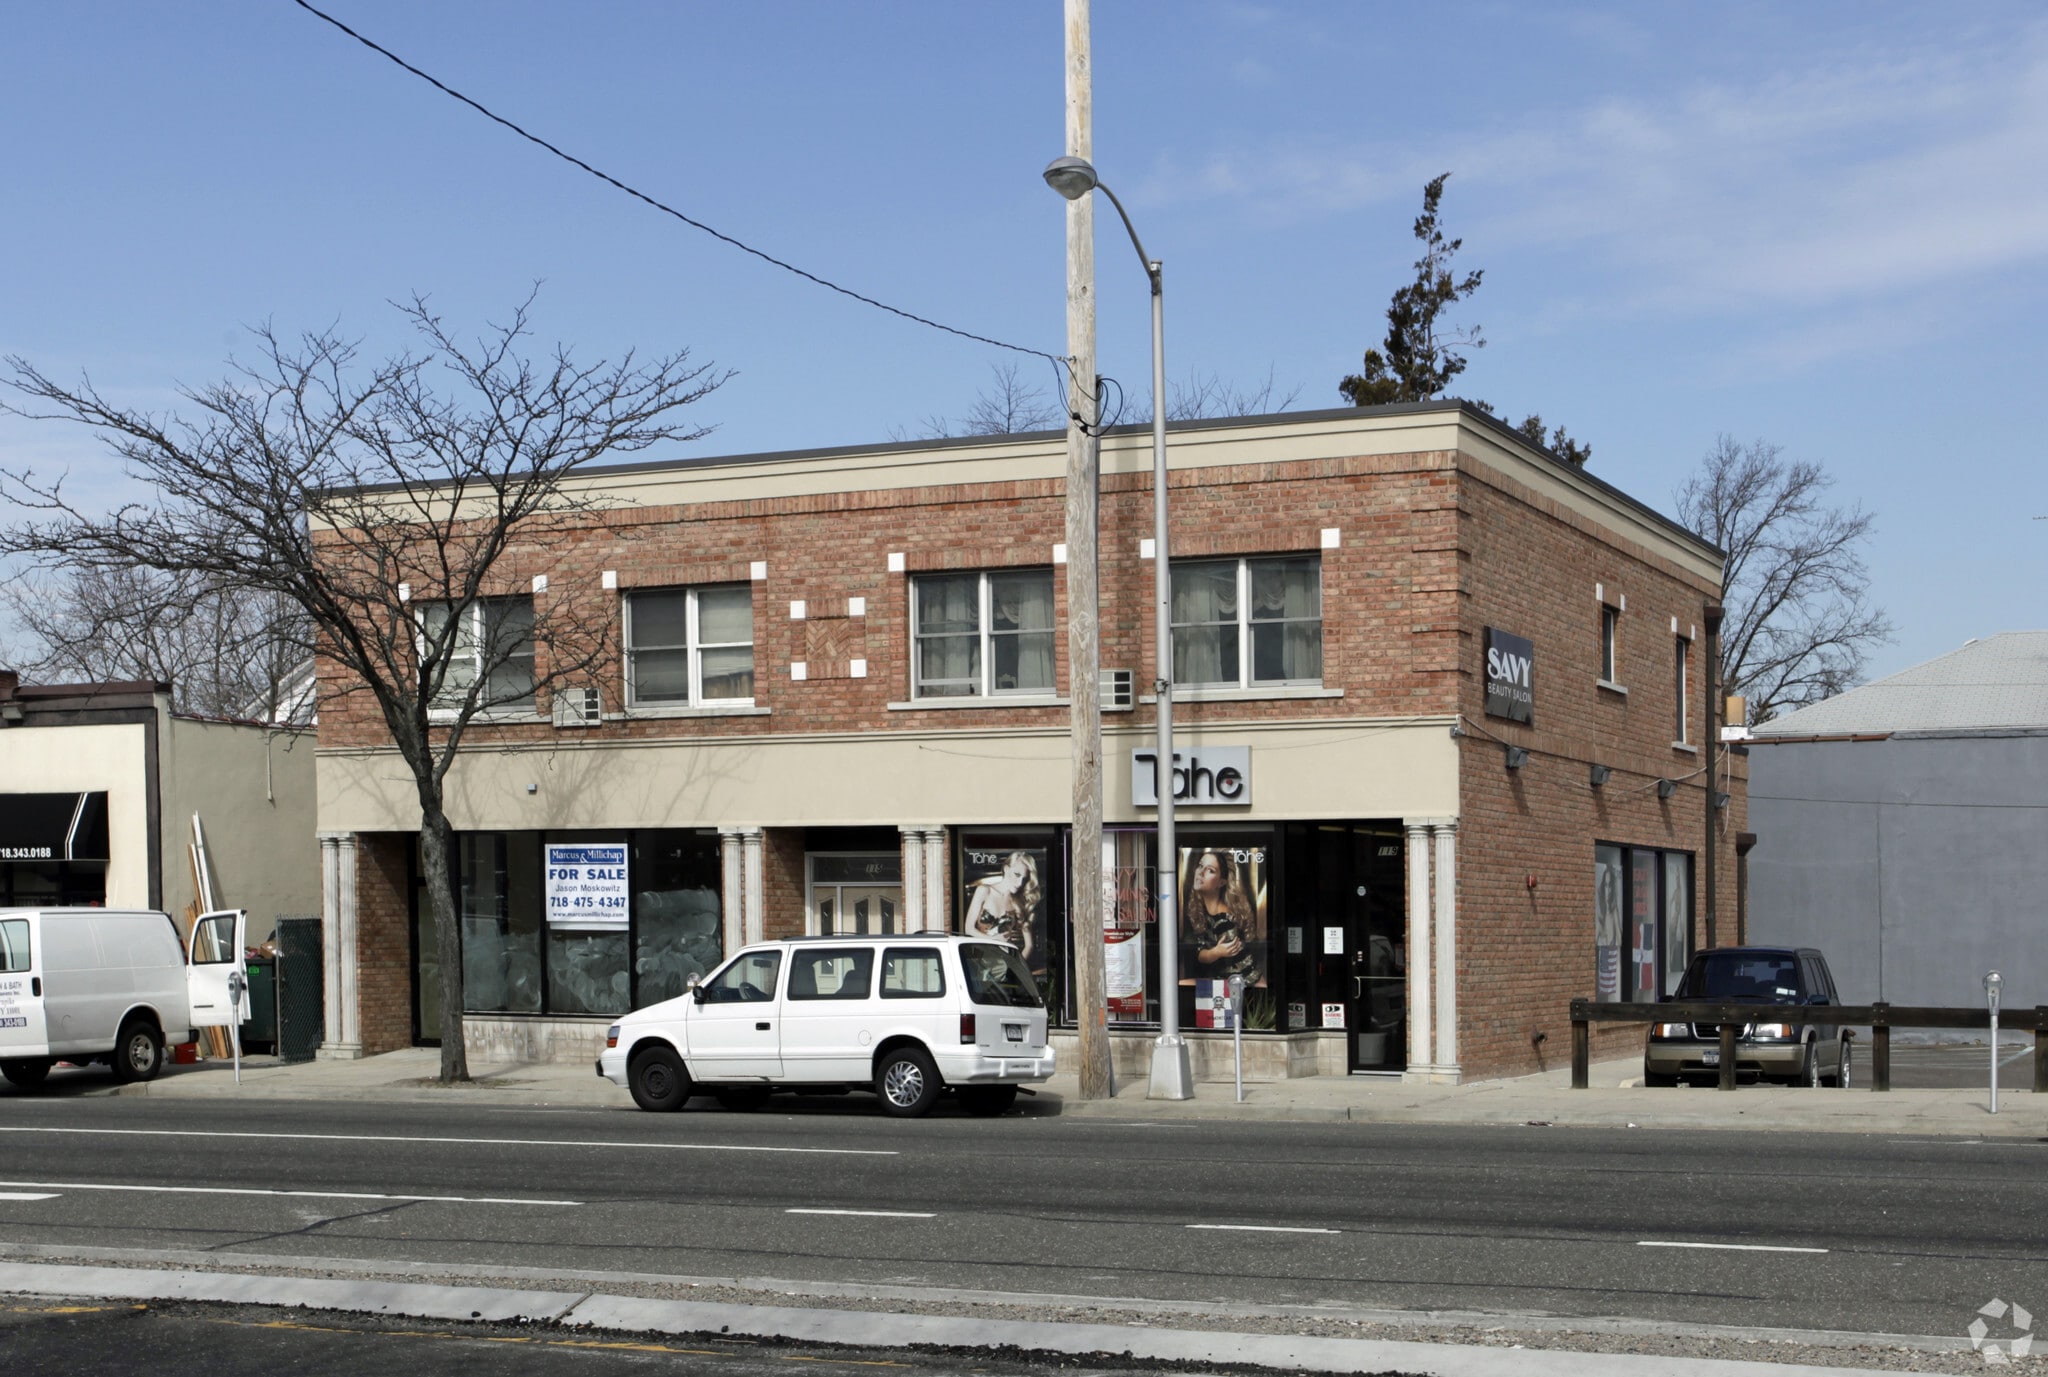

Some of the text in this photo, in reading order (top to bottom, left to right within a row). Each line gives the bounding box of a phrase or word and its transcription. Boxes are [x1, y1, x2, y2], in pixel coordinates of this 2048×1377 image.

[1488, 647, 1531, 688] SAVY
[1488, 682, 1532, 704] BEAUTY SALON
[0, 848, 51, 858] 18.343.0188
[552, 850, 623, 863] Marcus & Millichap
[969, 852, 997, 864] Tahe
[1229, 850, 1264, 863] Tahe
[549, 869, 626, 880] FOR SALE
[580, 884, 621, 892] Moskowitz
[550, 896, 626, 907] 718-475-4347
